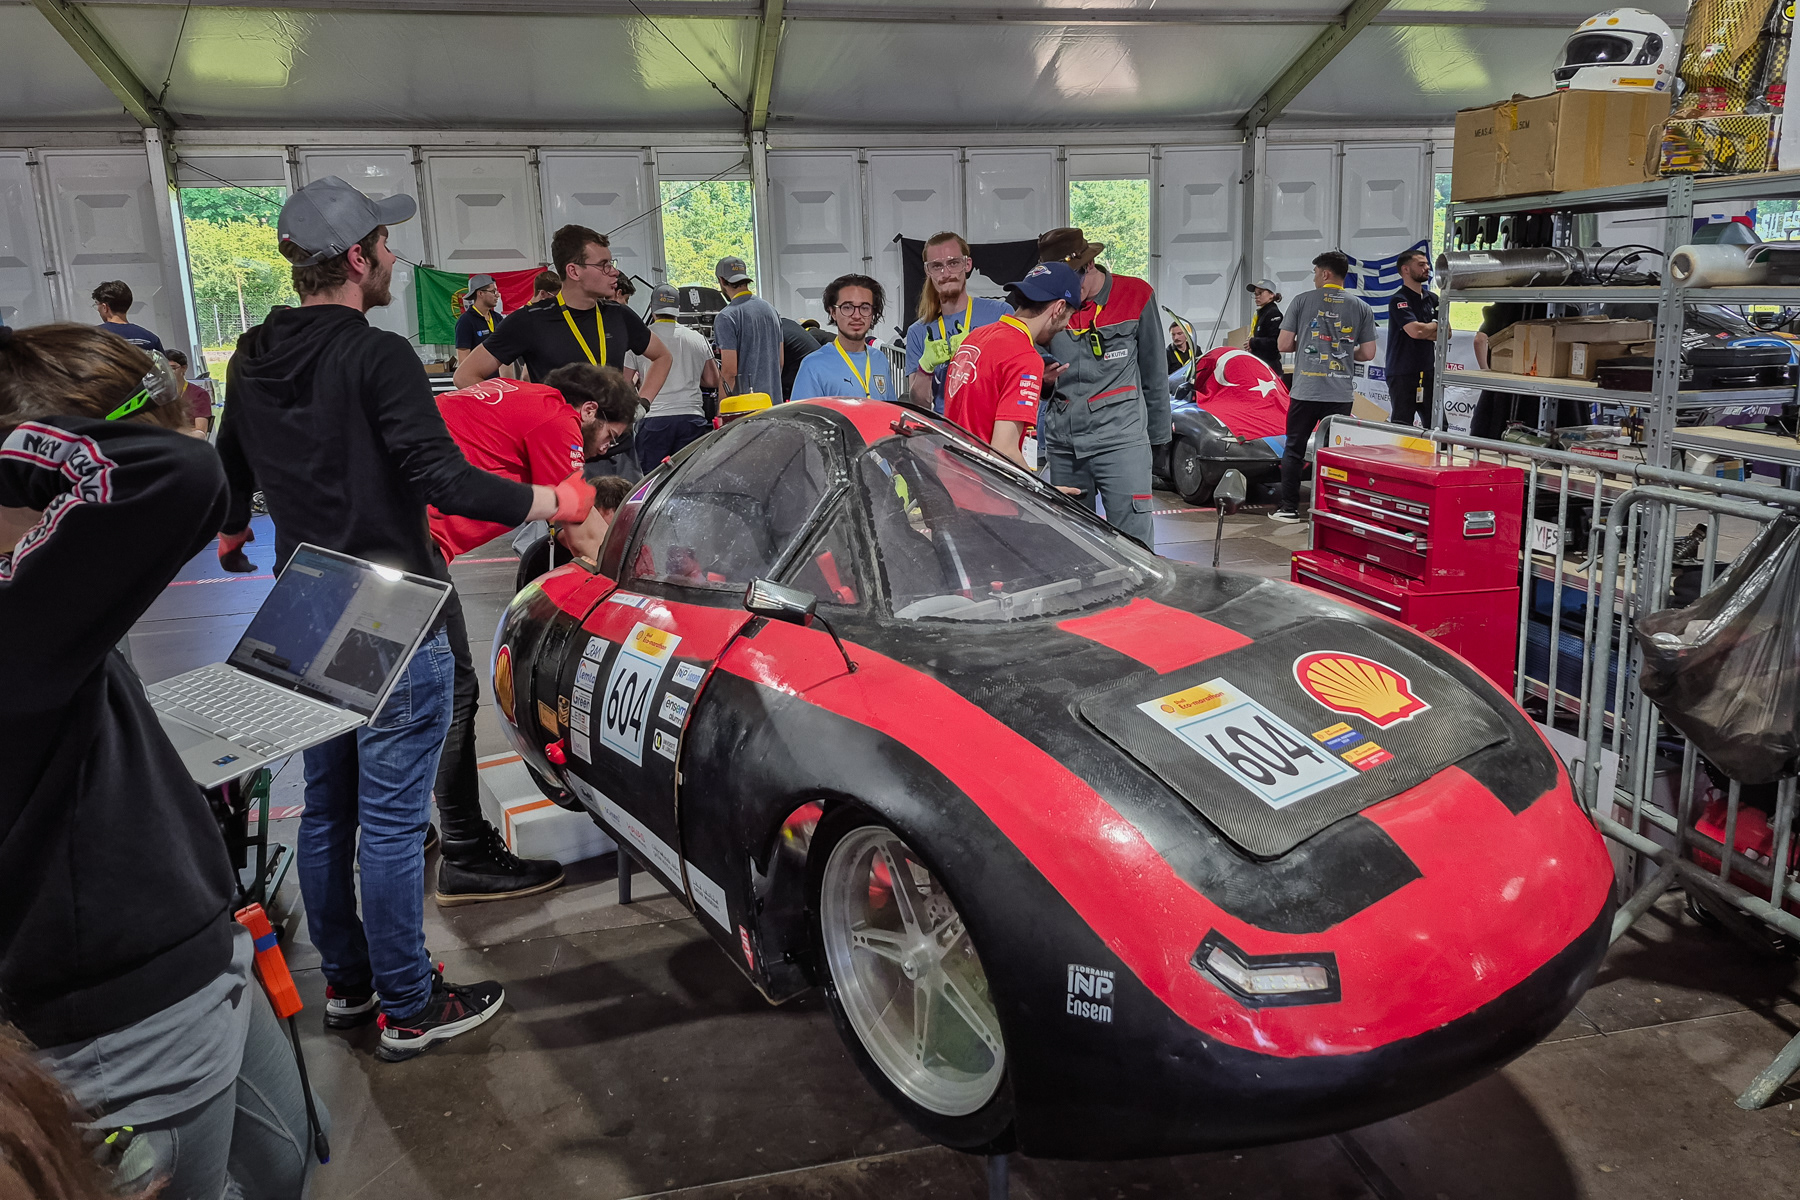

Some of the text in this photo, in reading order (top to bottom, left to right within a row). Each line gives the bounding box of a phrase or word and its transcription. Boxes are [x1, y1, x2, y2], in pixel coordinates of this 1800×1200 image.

[606, 667, 653, 743] 604
[1178, 691, 1225, 710] Eco-marathon
[1205, 714, 1325, 786] 604
[1067, 970, 1114, 999] INP
[1075, 965, 1115, 979] LORRAINE
[1066, 993, 1112, 1023] Ensem
